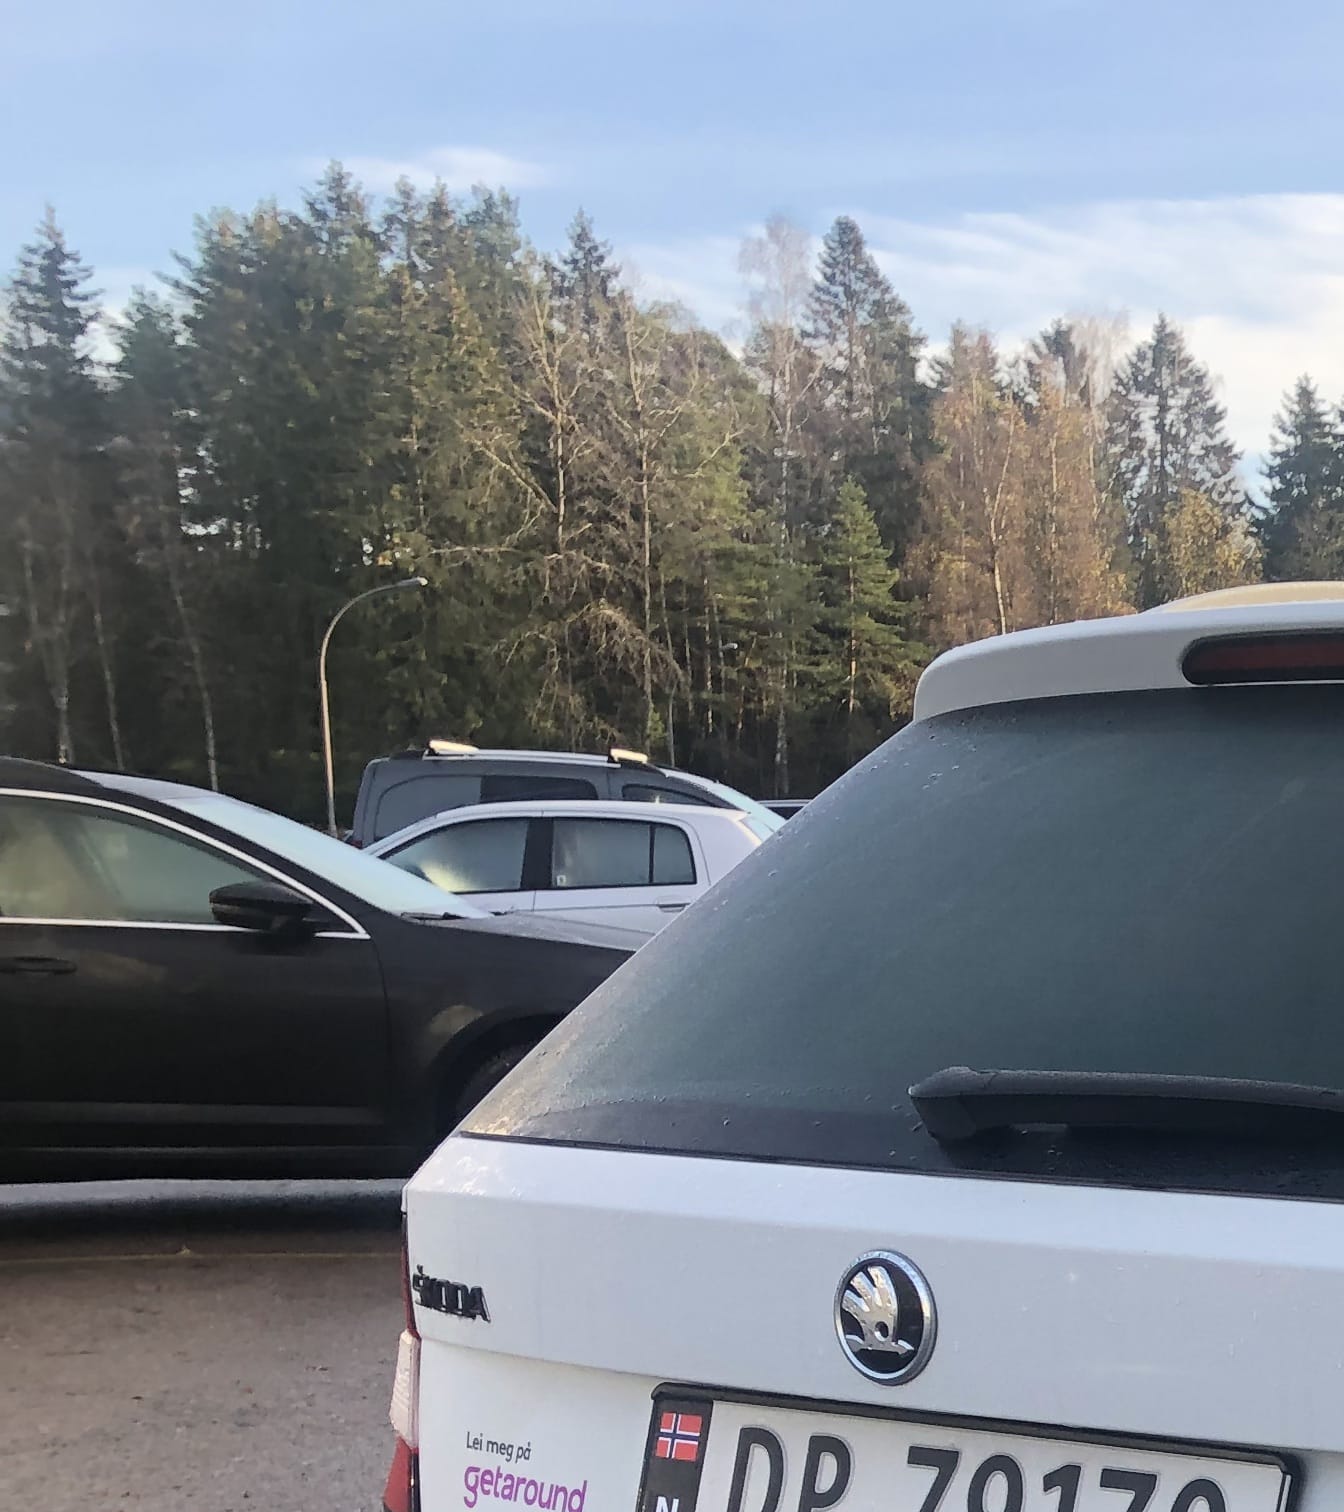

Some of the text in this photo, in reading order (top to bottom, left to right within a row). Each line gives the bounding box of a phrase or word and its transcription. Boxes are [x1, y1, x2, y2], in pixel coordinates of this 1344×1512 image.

[466, 1431, 532, 1464] Lei meg på
